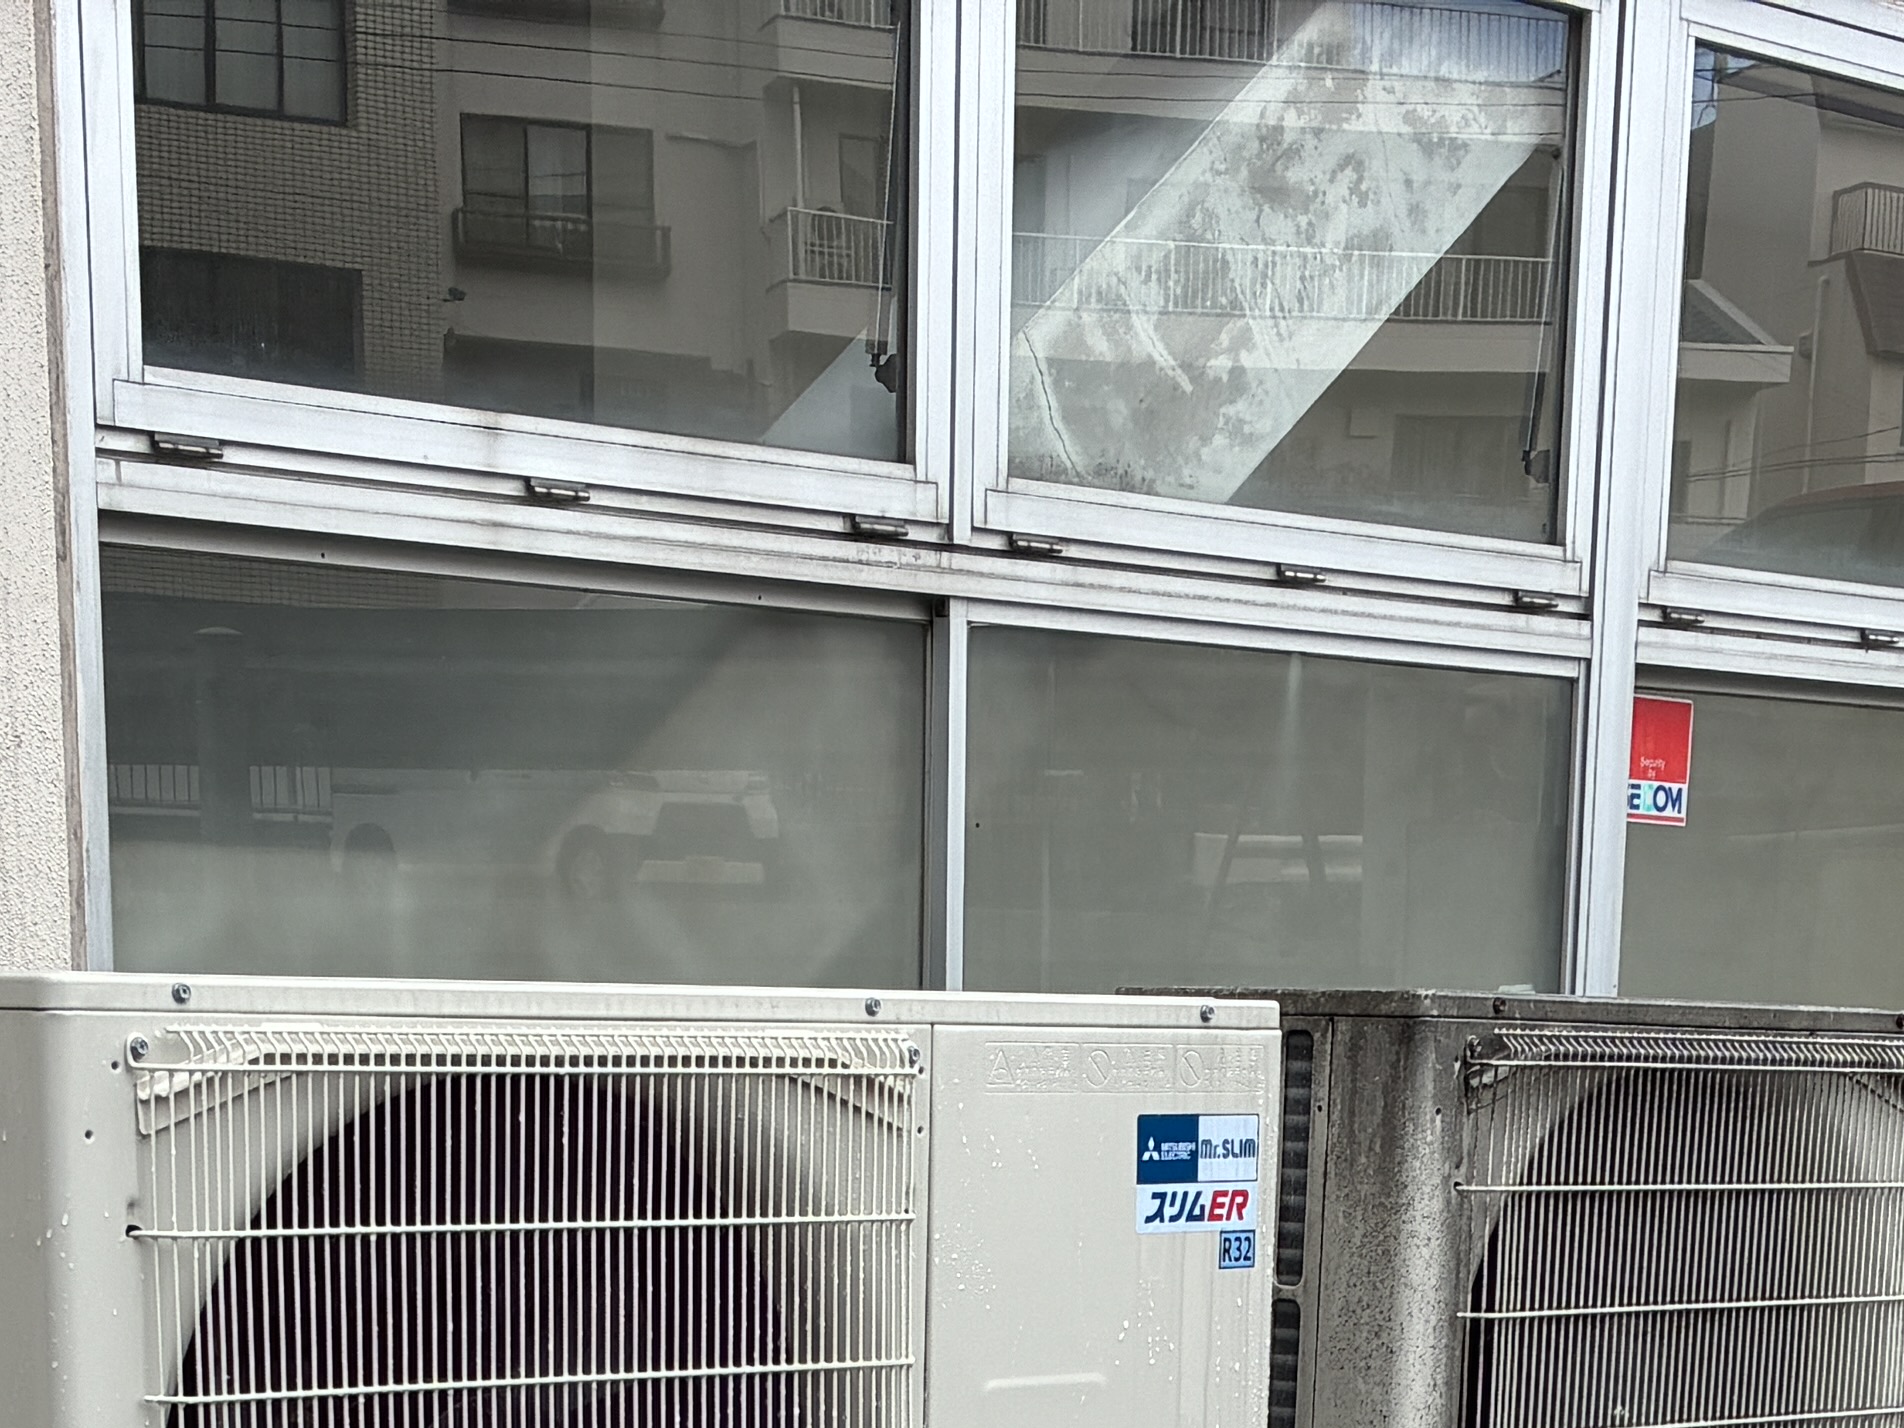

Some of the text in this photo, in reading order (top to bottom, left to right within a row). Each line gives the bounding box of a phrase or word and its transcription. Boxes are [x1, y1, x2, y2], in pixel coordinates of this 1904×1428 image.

[1627, 783, 1683, 814] ECOM
[1199, 1137, 1256, 1160] Mr.SLIM
[1144, 1189, 1250, 1225] スリムER
[1222, 1236, 1253, 1263] R32
